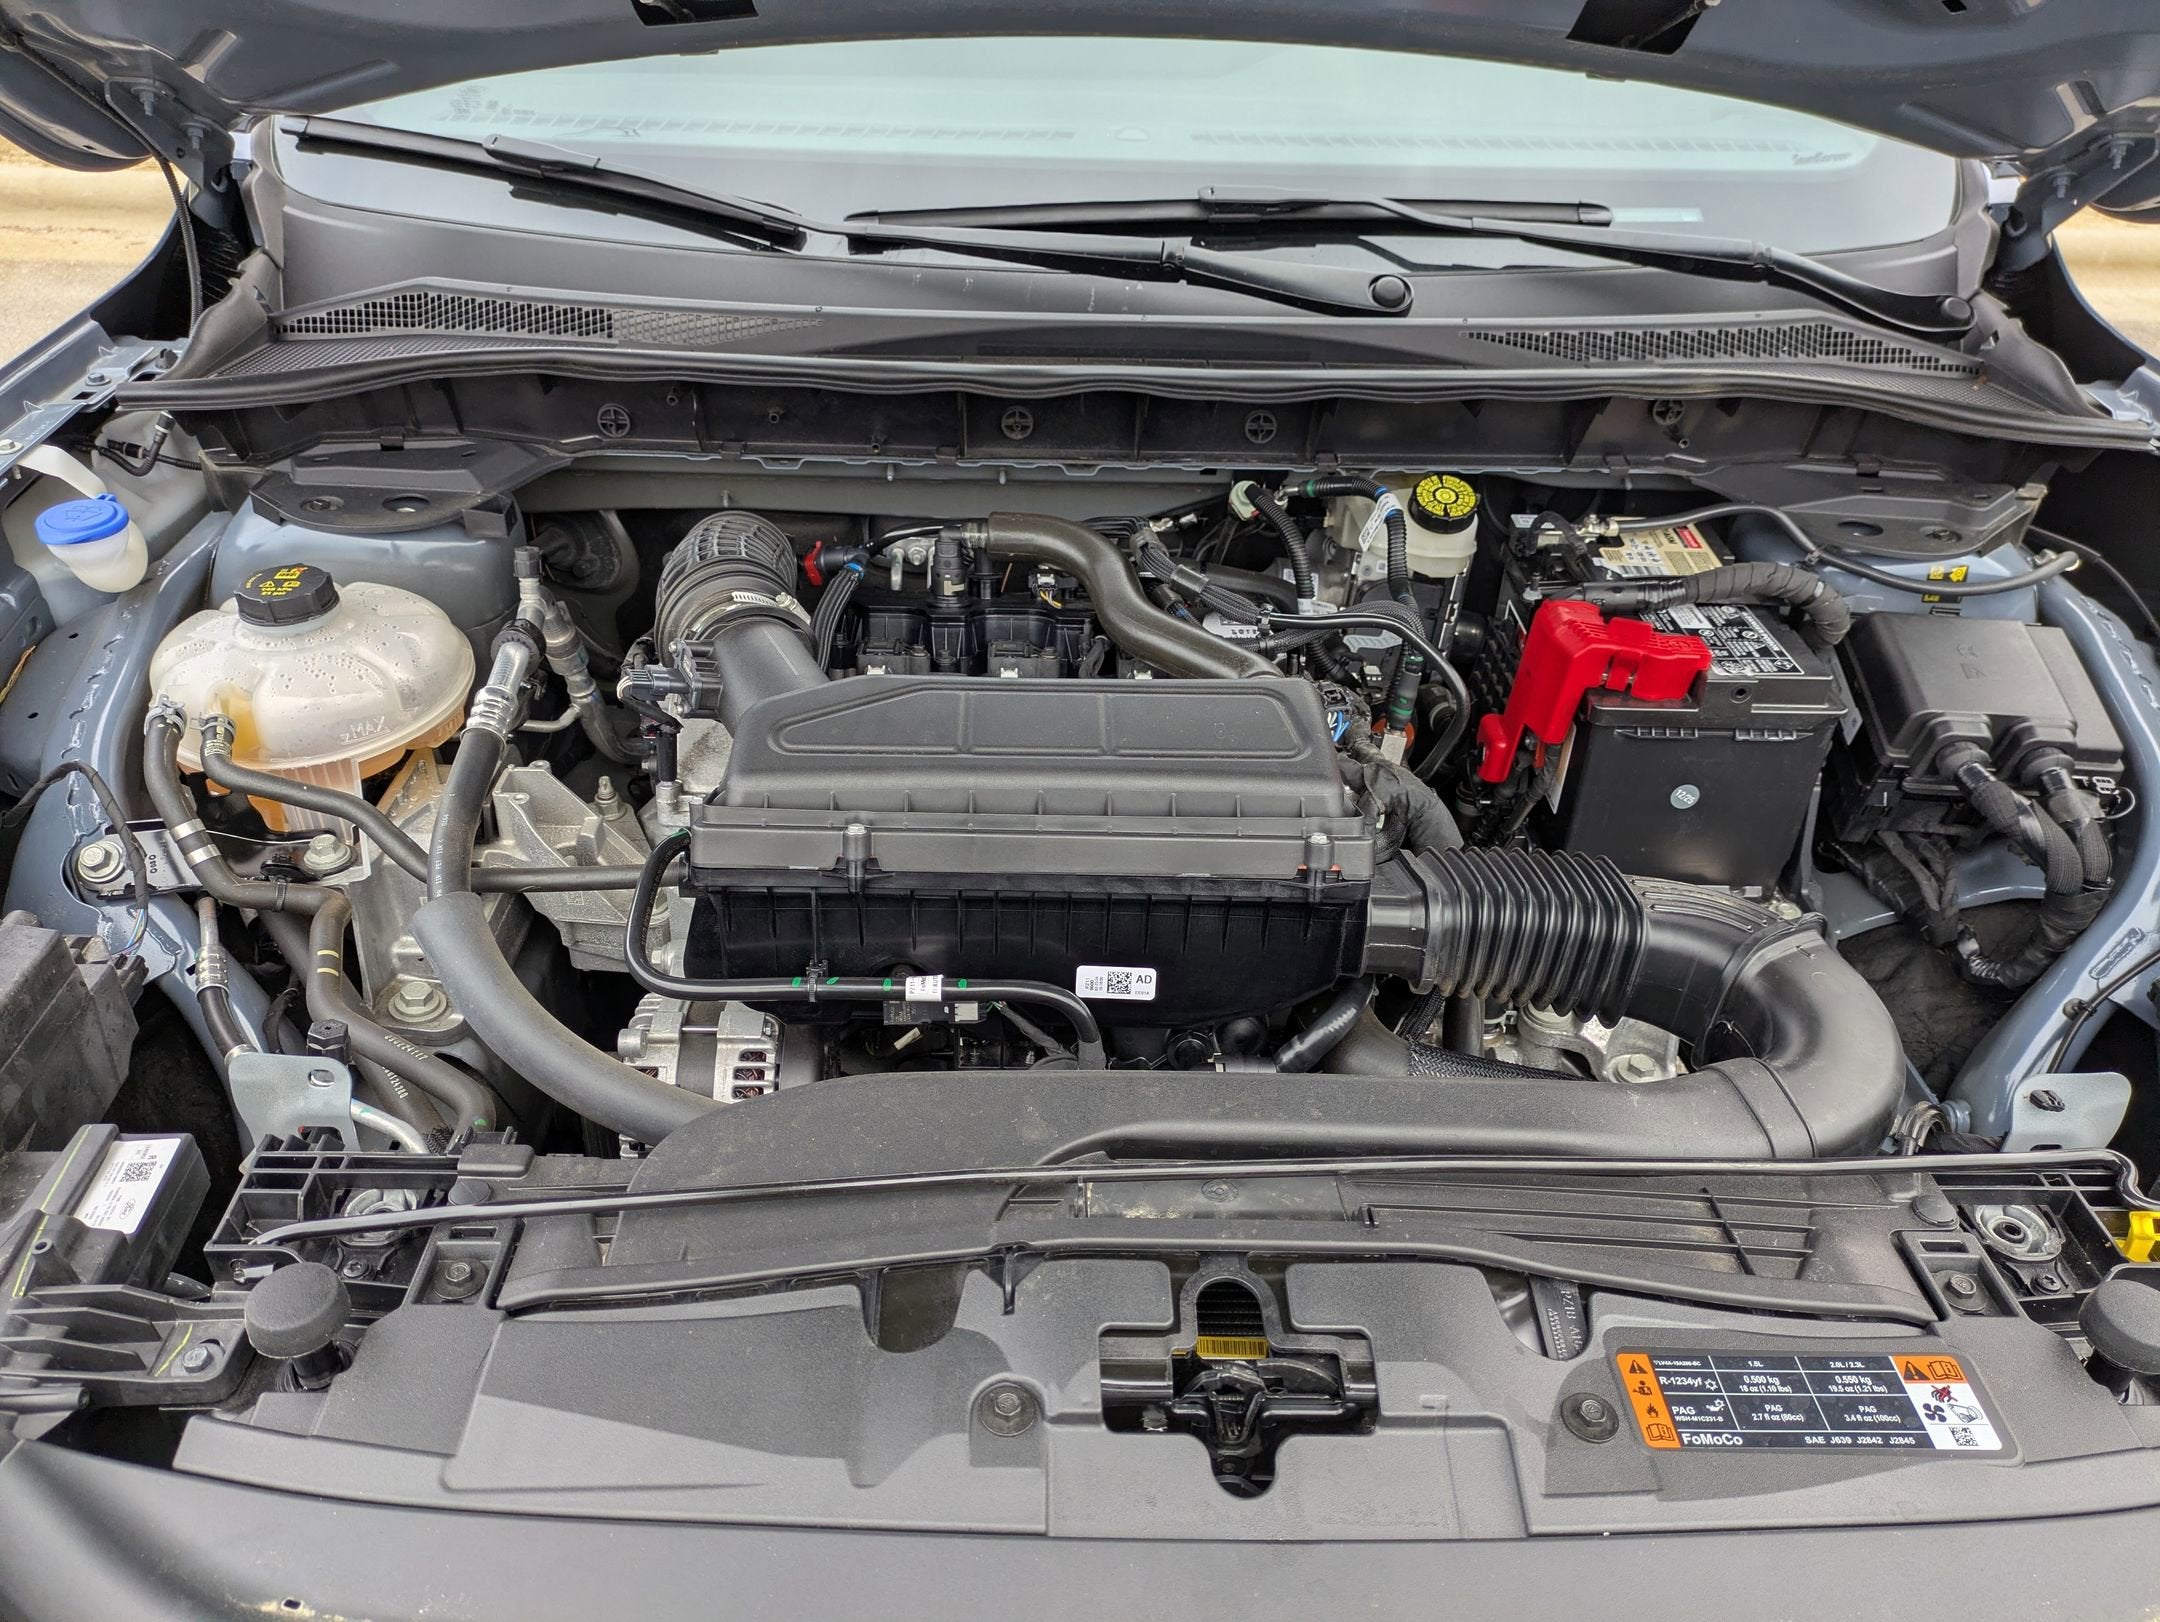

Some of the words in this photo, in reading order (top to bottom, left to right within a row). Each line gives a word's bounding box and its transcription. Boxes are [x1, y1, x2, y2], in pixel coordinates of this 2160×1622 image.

[350, 716, 385, 738] MAX
[1675, 789, 1695, 804] 12/25
[1136, 974, 1153, 985] AD
[1659, 1376, 1703, 1388] R-1234yf
[1743, 1375, 1767, 1384] 0.500
[1767, 1375, 1780, 1386] kg
[1834, 1375, 1858, 1384] 0.550
[1859, 1375, 1873, 1386] kg
[1759, 1385, 1777, 1394] (1.10
[1777, 1385, 1793, 1394] lbs)
[1855, 1385, 1872, 1394] (1.21
[1873, 1385, 1888, 1394] lbs)
[1671, 1406, 1696, 1415] PAG
[1764, 1404, 1783, 1412] PAG
[1858, 1405, 1877, 1413] PAG
[1751, 1413, 1763, 1421] 2.7
[1780, 1413, 1805, 1423] (80cc)
[1843, 1414, 1856, 1422] 3.4
[1873, 1414, 1901, 1424] (100cc)
[1681, 1433, 1744, 1446] FoMoCo
[1804, 1436, 1826, 1445] SAE
[1830, 1436, 1852, 1445] J639
[1856, 1436, 1884, 1445] J2842
[1889, 1436, 1916, 1445] J2845
